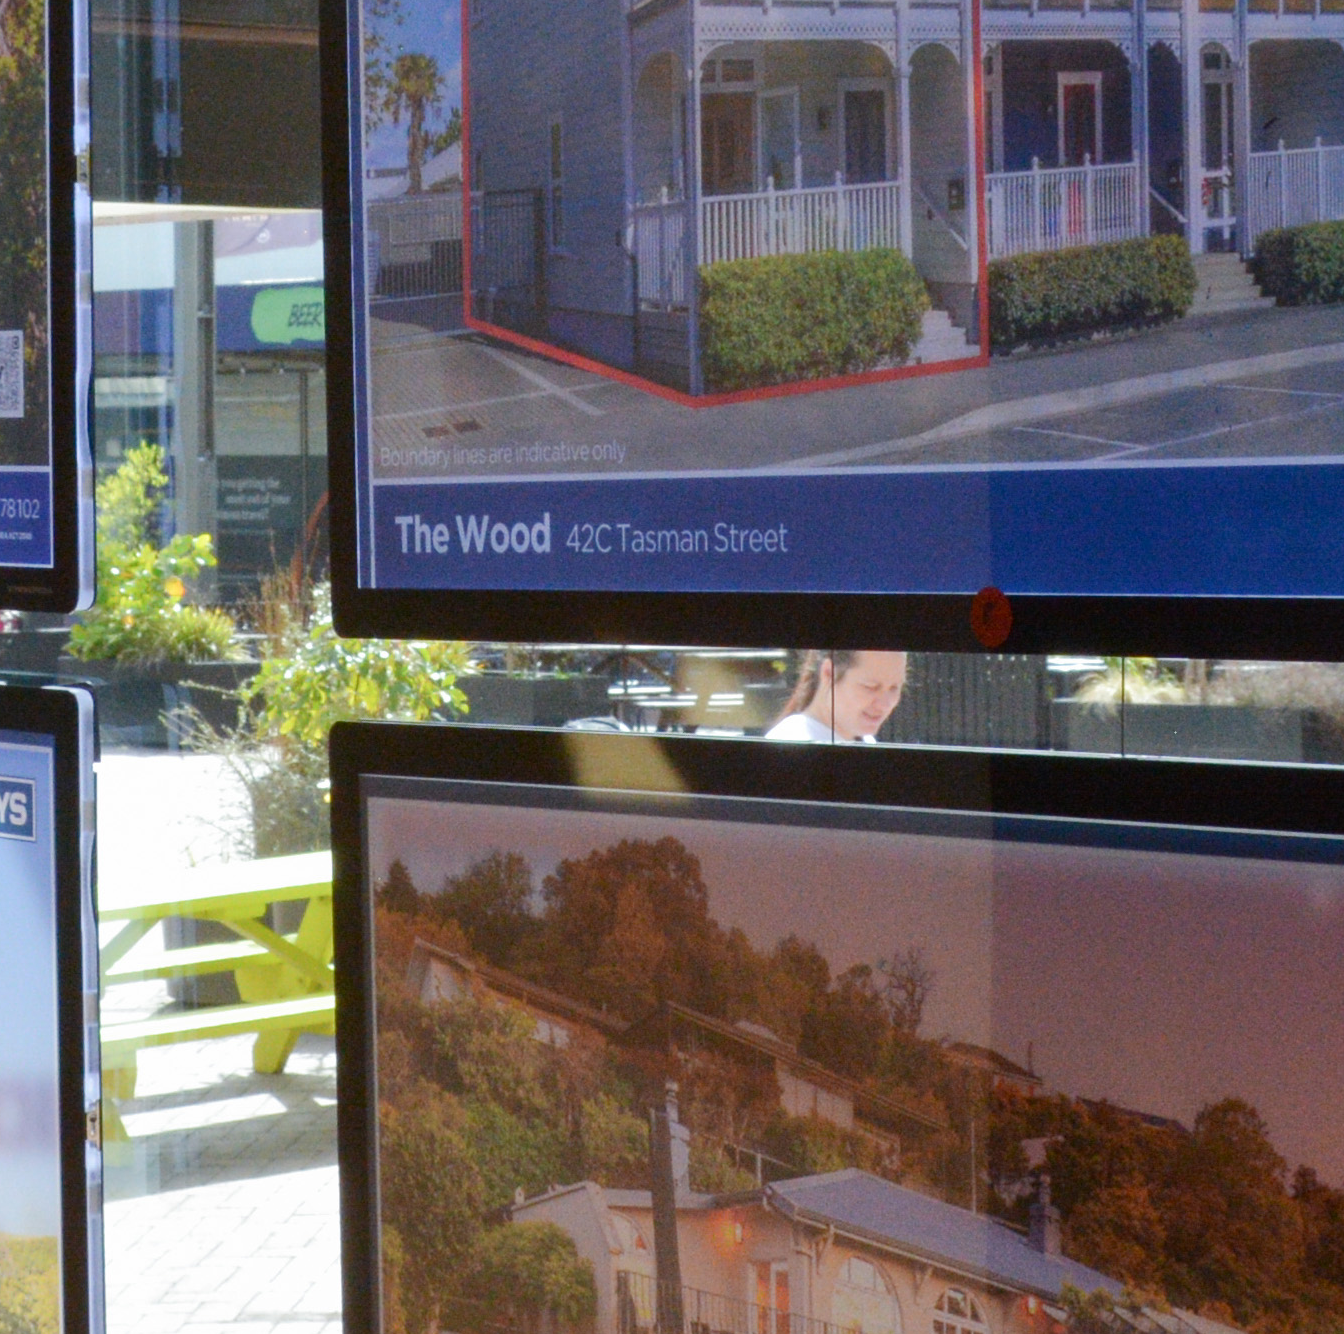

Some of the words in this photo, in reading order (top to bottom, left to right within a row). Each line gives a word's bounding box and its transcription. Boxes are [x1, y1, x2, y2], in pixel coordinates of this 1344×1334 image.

[380, 444, 450, 471] Boundary
[453, 444, 485, 466] lines
[488, 447, 513, 464] are
[515, 441, 589, 463] indicative
[592, 441, 626, 466] only
[395, 515, 449, 554] The
[456, 512, 551, 554] Wood
[567, 525, 613, 553] 42C
[618, 523, 708, 553] Tasman
[714, 522, 788, 553] Street
